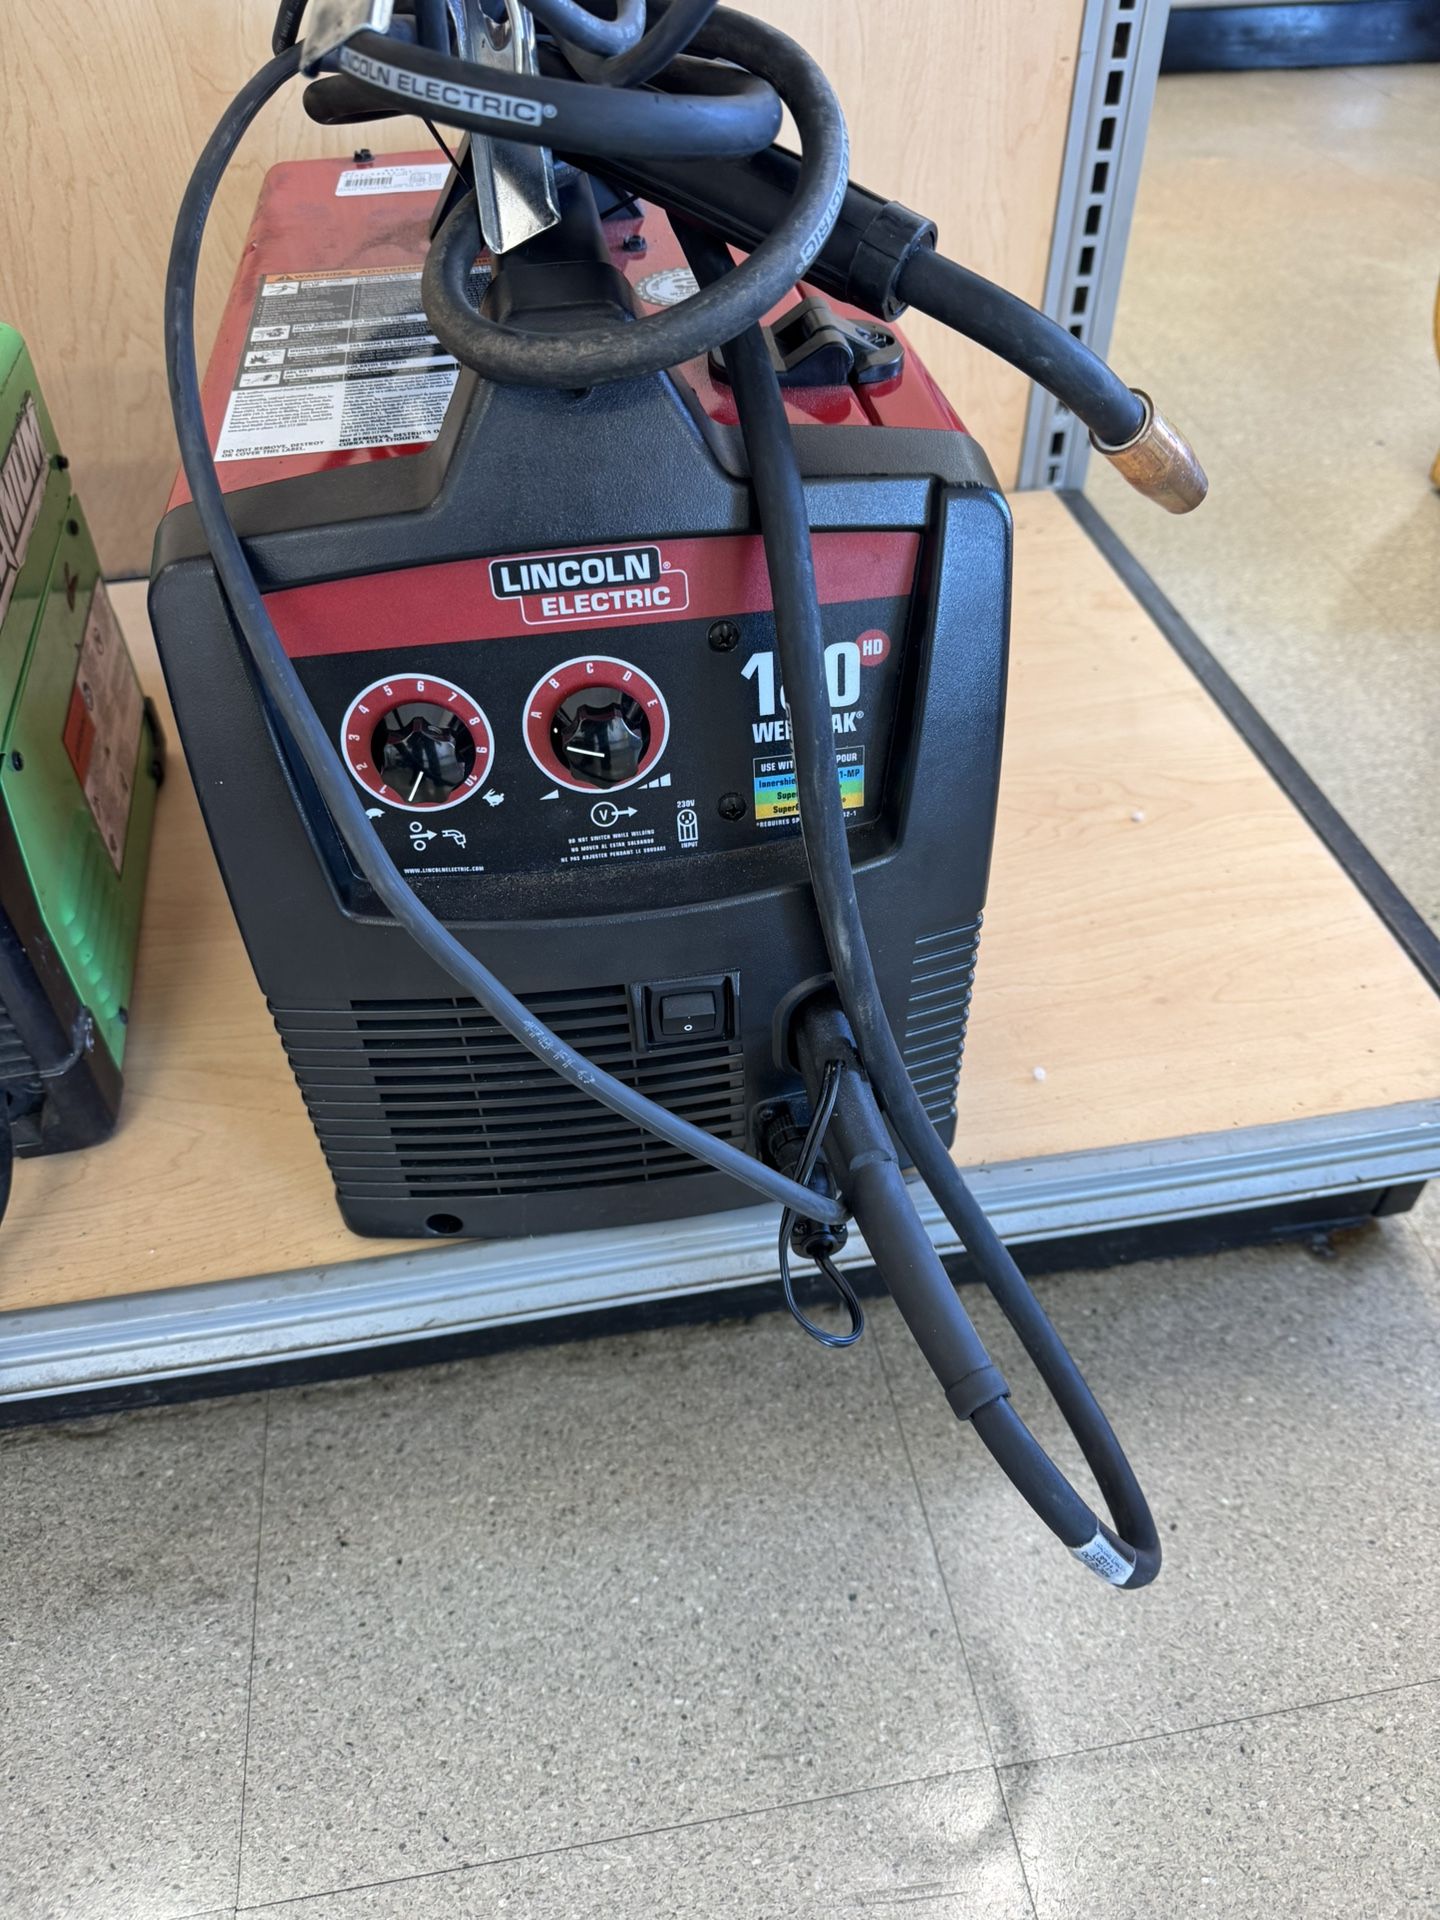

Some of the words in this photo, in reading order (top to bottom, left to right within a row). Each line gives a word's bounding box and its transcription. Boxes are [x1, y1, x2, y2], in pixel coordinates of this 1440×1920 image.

[397, 74, 536, 122] ELECTRIC
[295, 271, 352, 279] WARNING
[359, 265, 424, 275] ADVERTEN
[290, 440, 325, 448] DESTROY
[500, 553, 651, 593] LINCOLN
[541, 586, 671, 617] ELECTRIC
[862, 638, 884, 657] HD
[740, 641, 861, 716] 10
[383, 684, 393, 697] 5
[416, 680, 425, 692] 6
[530, 710, 542, 719] A
[548, 678, 560, 689] B
[585, 662, 594, 674] C
[622, 670, 632, 682] D
[646, 698, 659, 708] E
[448, 691, 458, 702] 7
[358, 703, 370, 714] 4
[469, 716, 481, 726] 8
[348, 733, 360, 741] 3
[476, 746, 488, 754] 9
[356, 761, 368, 771] 2
[760, 762, 776, 772] USE
[777, 760, 794, 771] WIT
[836, 752, 858, 763] POUR
[464, 774, 478, 787] 10
[379, 784, 388, 794] 1
[676, 799, 696, 809] 230V
[598, 809, 608, 821] V
[631, 829, 655, 837] WELDING
[580, 844, 599, 852] MOVER
[609, 841, 625, 849] ESTAR
[681, 841, 698, 849] INPUT
[609, 849, 634, 857] PENDANT
[403, 866, 485, 875] WWW.LINCOLNELECTRIC.COM
